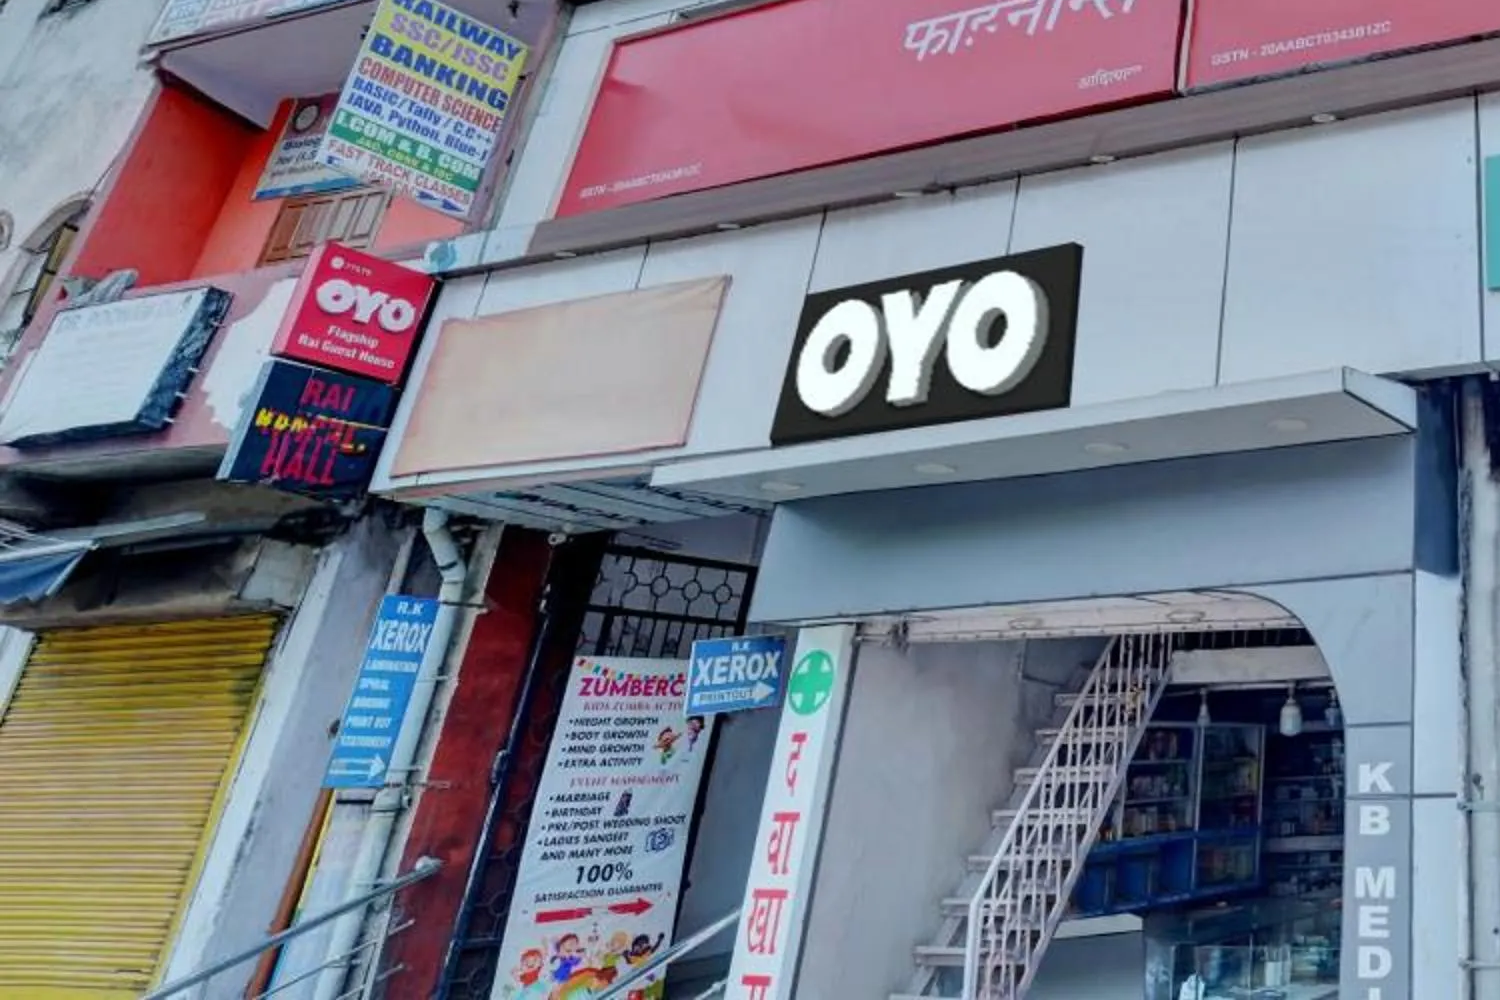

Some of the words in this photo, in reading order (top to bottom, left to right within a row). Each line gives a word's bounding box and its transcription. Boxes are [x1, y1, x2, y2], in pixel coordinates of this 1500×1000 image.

[369, 31, 511, 113] BANKING
[357, 55, 442, 108] COMPUTER
[441, 90, 503, 133] SCIENCE
[316, 278, 417, 333] OYO
[327, 325, 379, 350] Flagship
[796, 269, 1050, 418] OYO
[321, 340, 357, 359] Guest
[358, 351, 396, 370] House
[299, 378, 357, 413] RAI
[370, 619, 432, 653] XEROX
[693, 651, 781, 687] XEROX
[578, 676, 687, 698] ZUMBERC
[613, 716, 659, 727] GROWTH
[602, 730, 650, 740] GROWTH
[566, 743, 597, 754] MIND
[600, 743, 645, 753] GROWTH
[563, 757, 597, 769] EXTRA
[555, 792, 611, 803] MARRIAGE
[1358, 761, 1395, 836] KB
[546, 821, 600, 833] PRE/POST
[602, 817, 651, 829] WEDDING
[653, 814, 687, 825] SHOOT
[551, 807, 603, 818] BIRTHDAY
[543, 834, 581, 847] LADIES
[540, 850, 565, 861] AND
[568, 848, 601, 860] MANY
[603, 845, 634, 855] MORE
[574, 861, 634, 885] 100%
[534, 888, 605, 904] SATISFACTION
